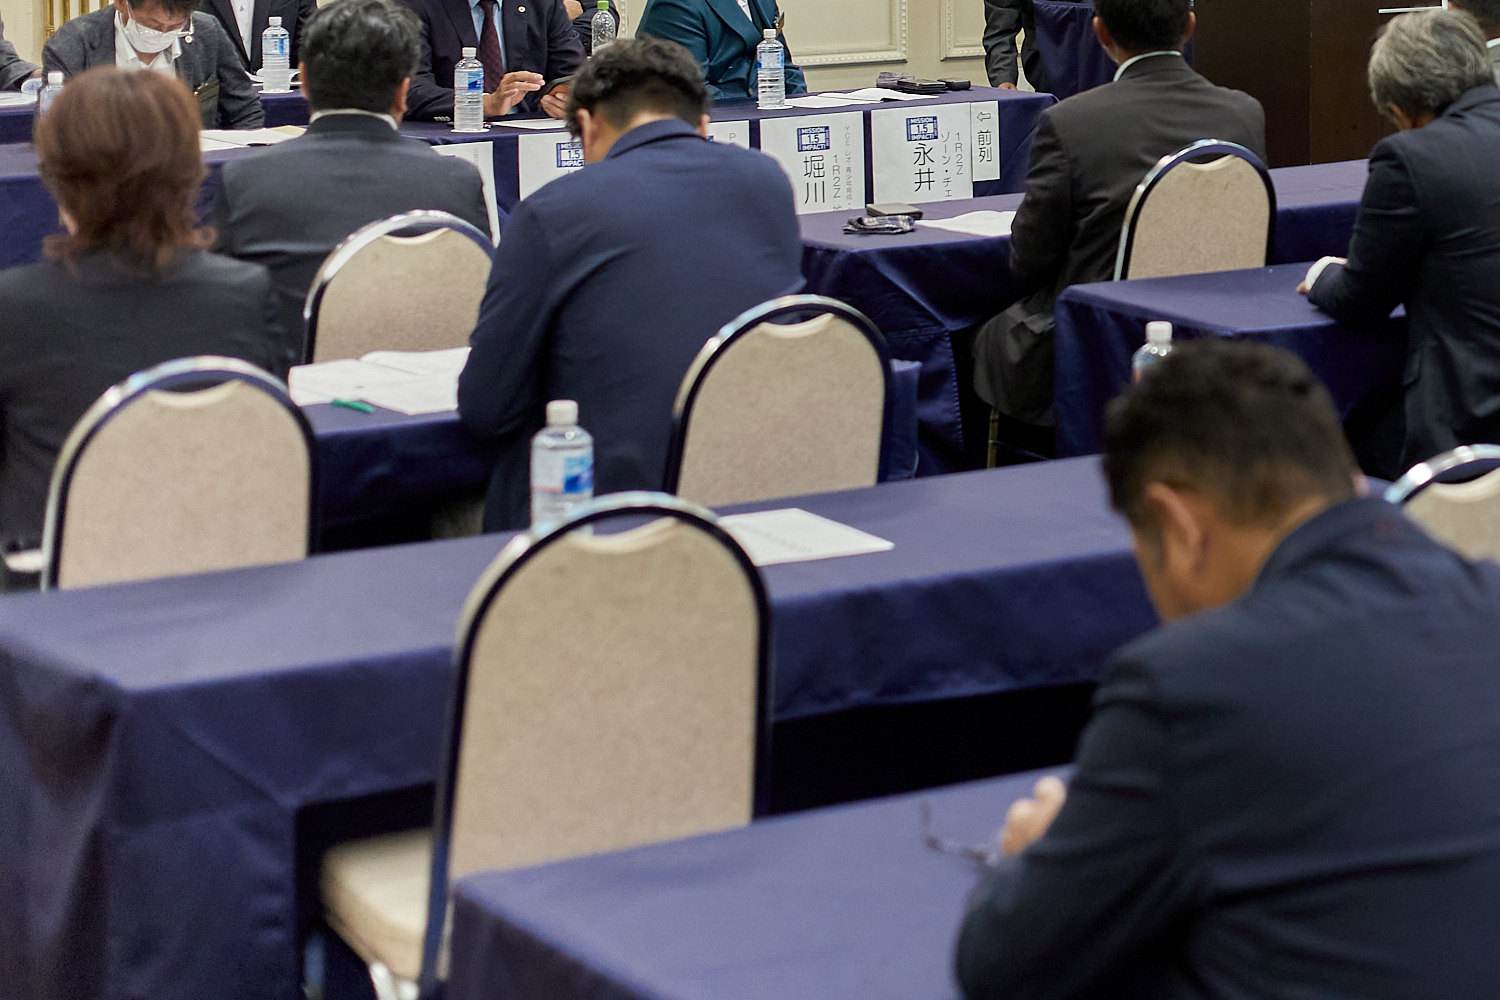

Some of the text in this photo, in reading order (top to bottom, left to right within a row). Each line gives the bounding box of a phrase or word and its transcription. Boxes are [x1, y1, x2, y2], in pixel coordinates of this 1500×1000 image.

[807, 134, 820, 144] 1.5
[916, 124, 929, 134] 1.5
[977, 129, 993, 163] 前列
[568, 149, 581, 159] 1.5
[913, 142, 936, 192] 永井
[954, 131, 964, 176] 1R2Z
[803, 154, 826, 205] 堀川
[832, 154, 842, 199] 1R2Z
